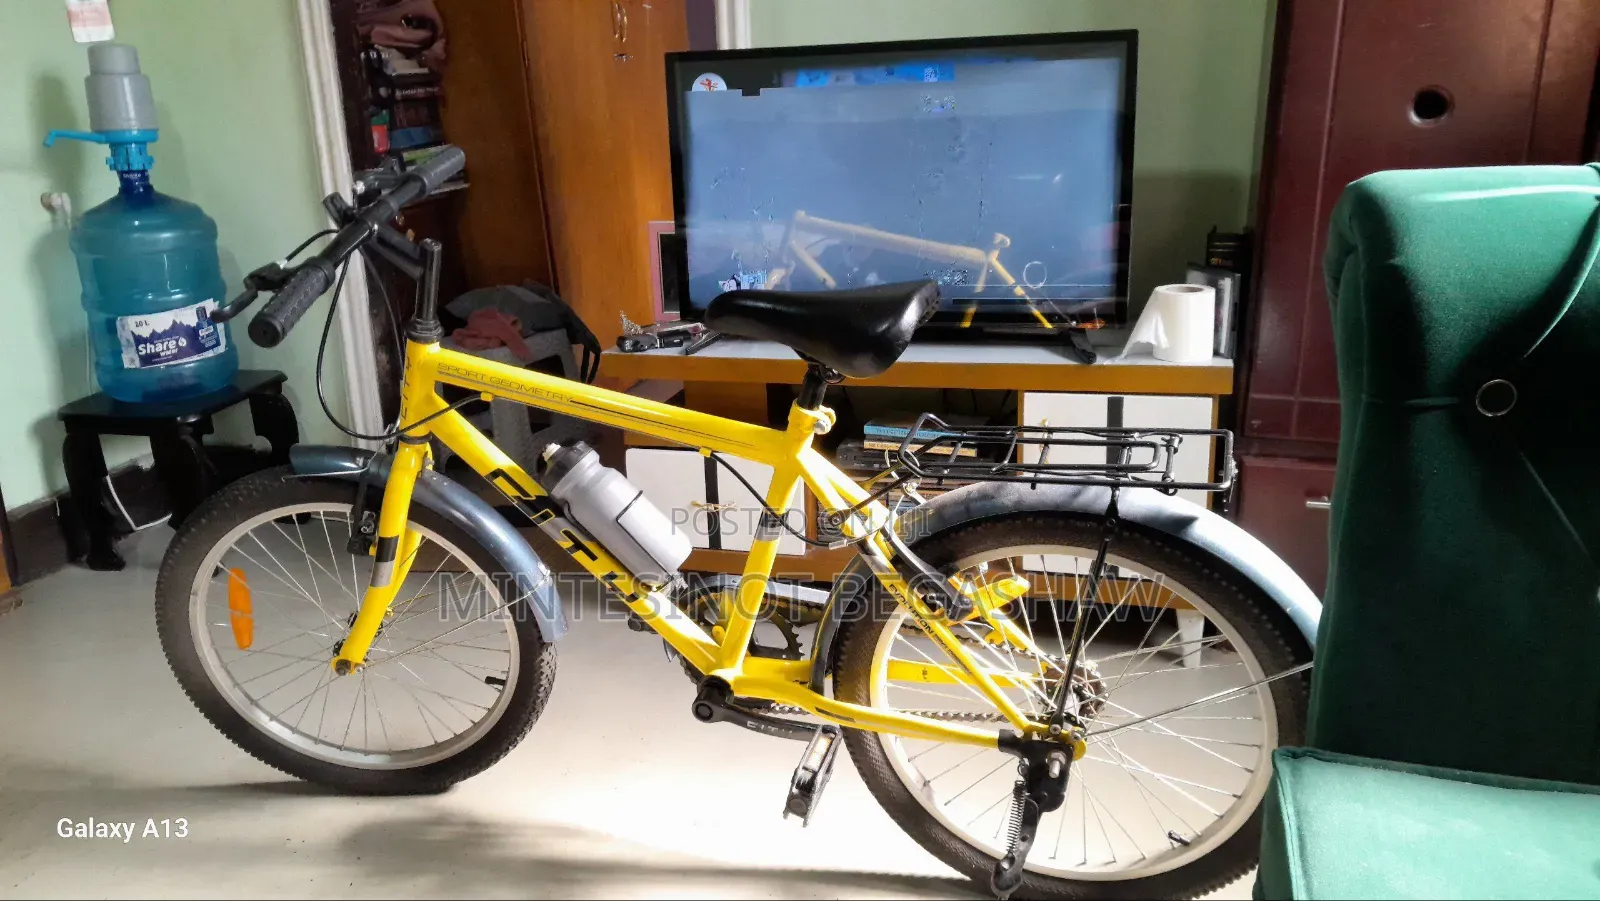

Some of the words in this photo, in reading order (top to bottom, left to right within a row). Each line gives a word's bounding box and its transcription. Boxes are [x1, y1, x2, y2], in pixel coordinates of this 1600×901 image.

[437, 362, 487, 381] SPORT
[489, 376, 575, 402] GEOMETRY
[888, 583, 934, 634] EVOLUTION
